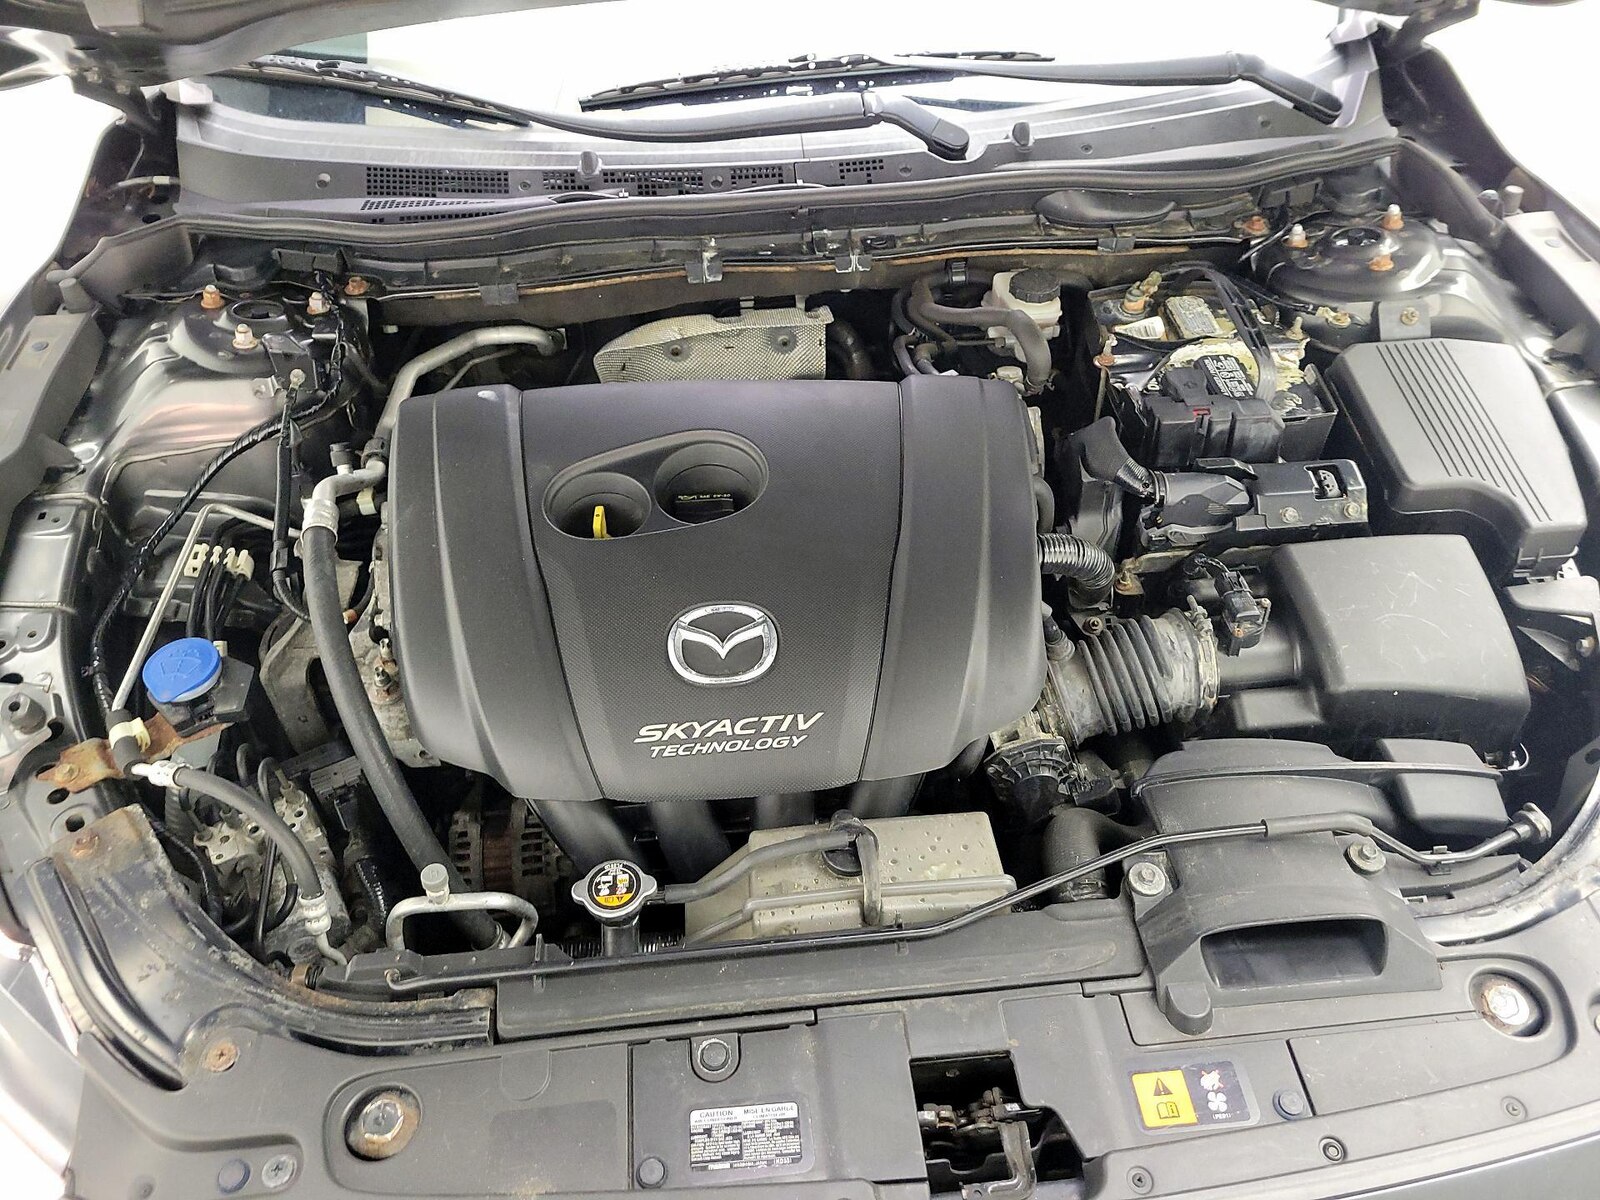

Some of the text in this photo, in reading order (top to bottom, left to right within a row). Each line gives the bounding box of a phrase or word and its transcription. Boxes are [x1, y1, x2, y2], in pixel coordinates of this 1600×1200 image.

[633, 712, 824, 743] SKYACTIV
[651, 735, 808, 758] TECHNOLOGY
[699, 1110, 734, 1118] CAUTION
